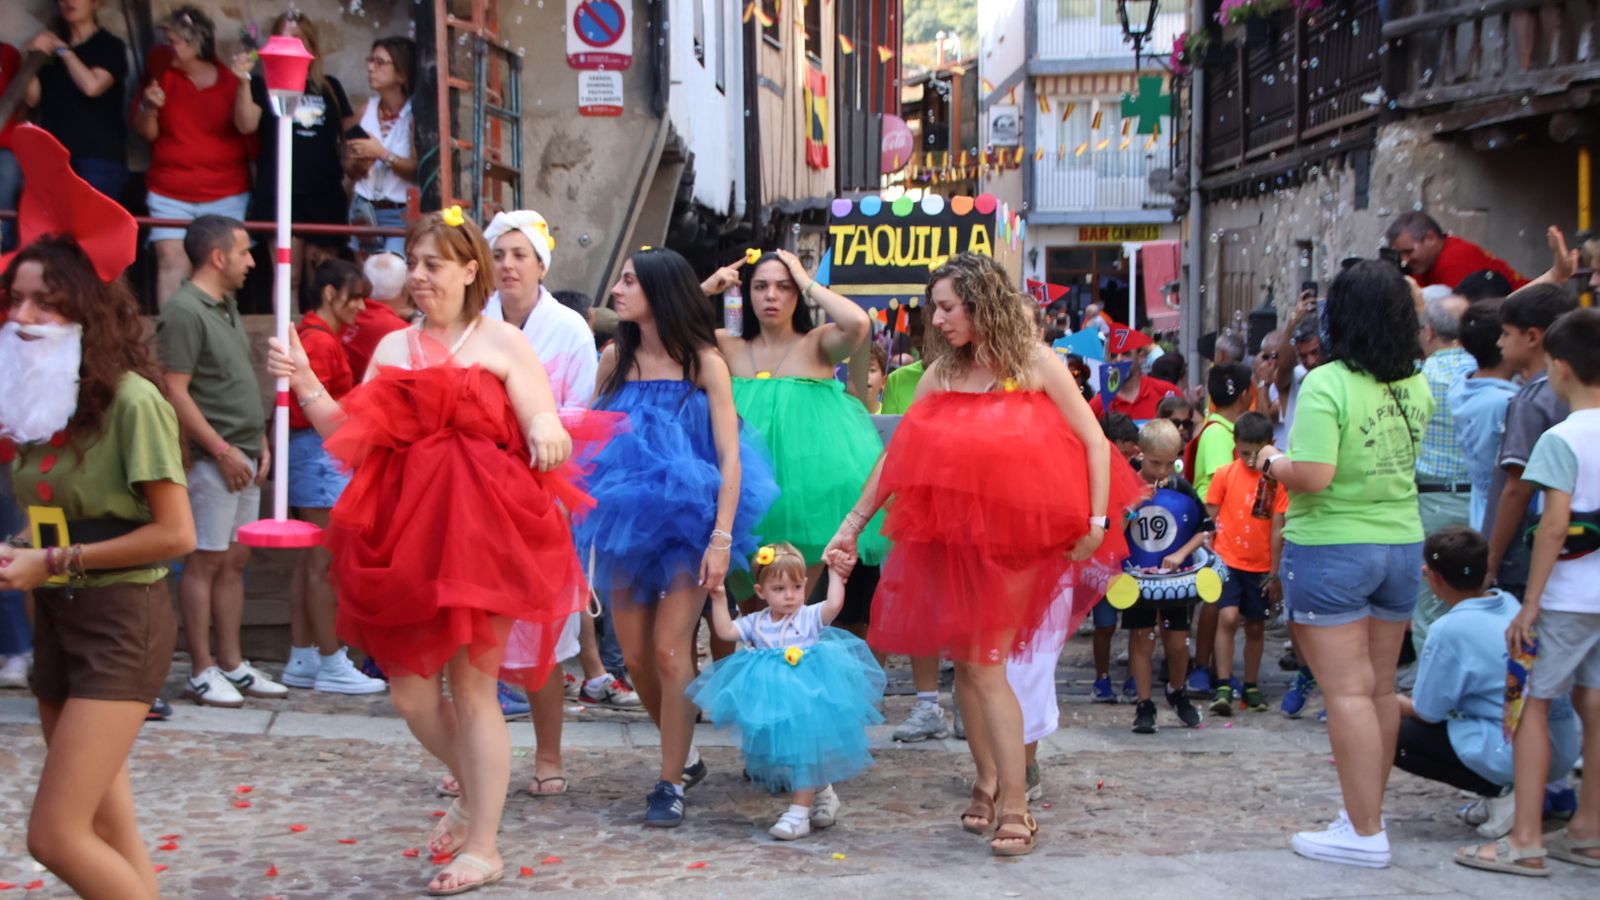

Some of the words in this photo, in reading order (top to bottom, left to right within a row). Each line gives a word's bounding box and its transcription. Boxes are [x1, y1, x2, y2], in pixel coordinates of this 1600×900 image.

[1079, 225, 1109, 241] BAR
[829, 224, 993, 267] TAQUILLA
[1115, 329, 1130, 349] 7
[1137, 515, 1168, 541] 19
